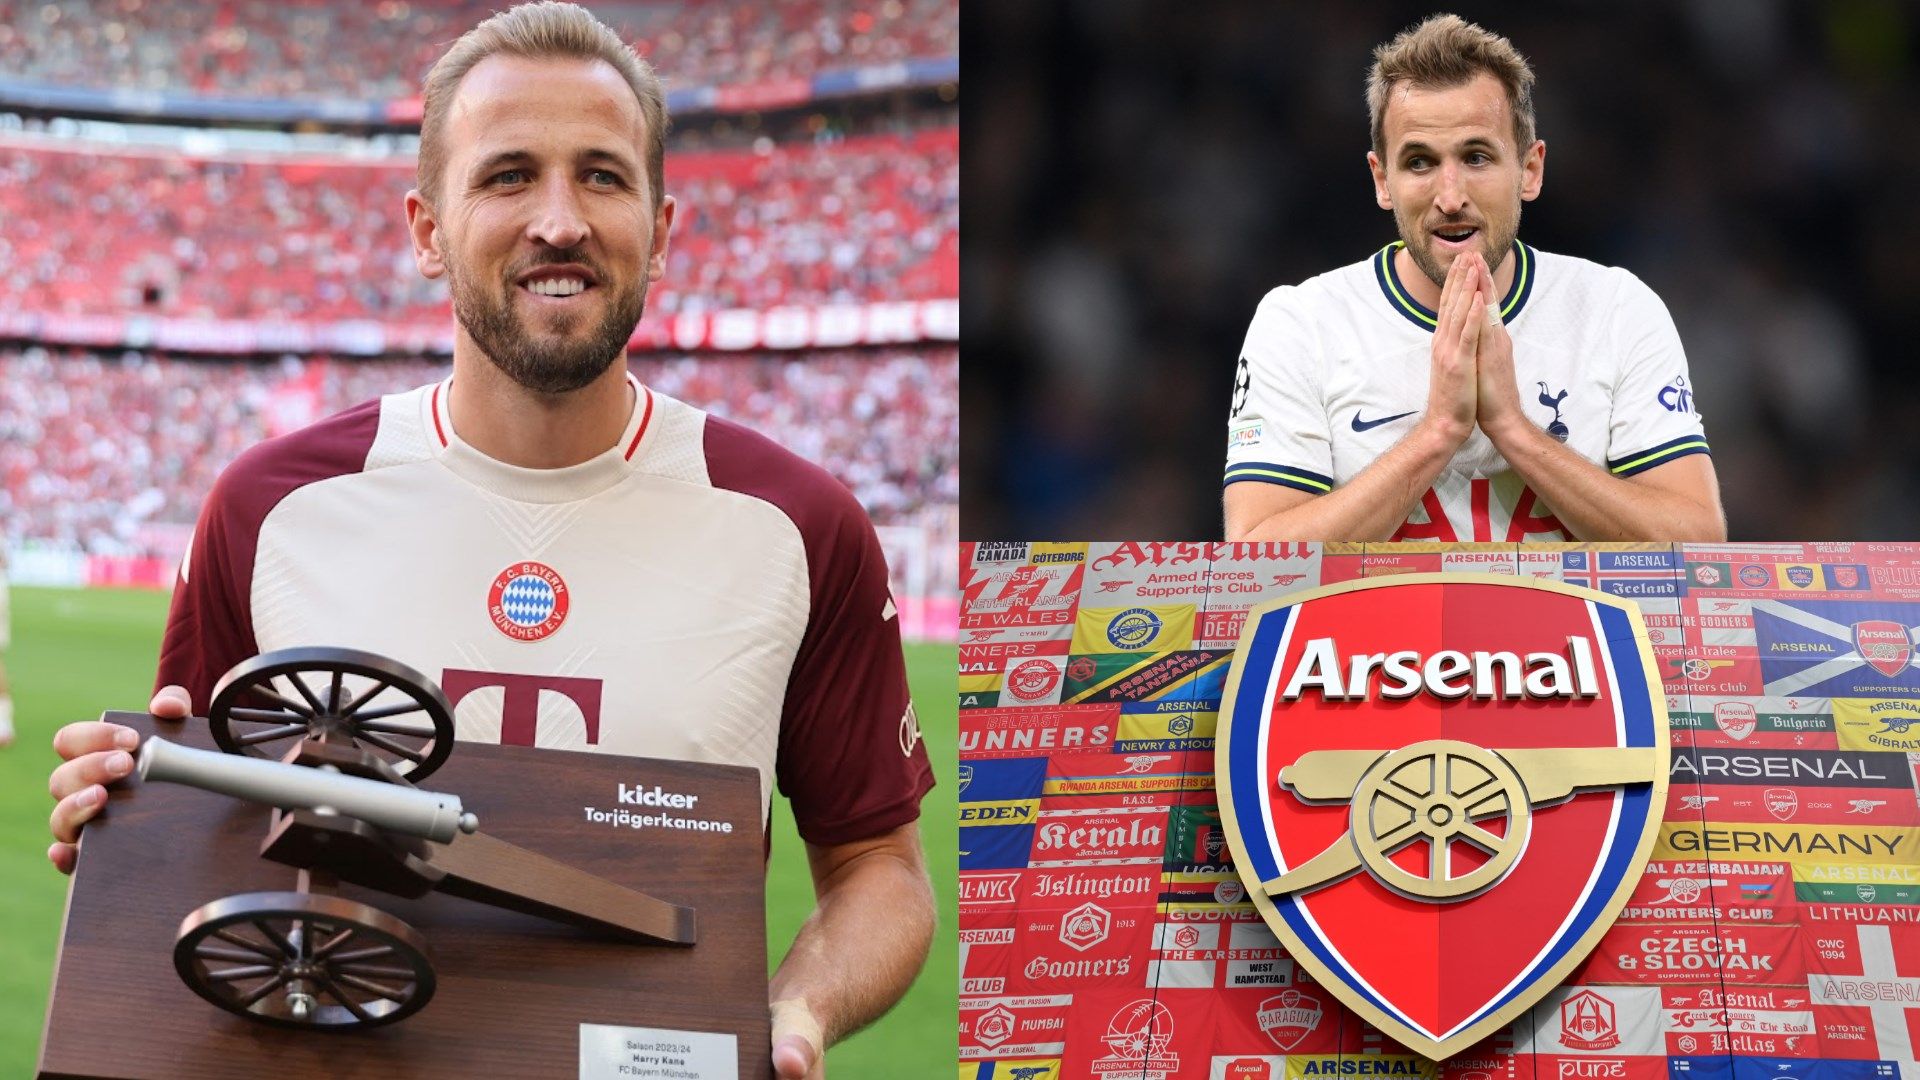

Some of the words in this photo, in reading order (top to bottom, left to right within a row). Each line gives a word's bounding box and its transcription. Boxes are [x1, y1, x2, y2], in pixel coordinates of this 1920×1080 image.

[979, 542, 1028, 550] ARSENAL
[976, 548, 1026, 562] CANADA
[1032, 552, 1084, 563] GÖTEBORG
[1091, 542, 1315, 572] Arsenal
[1361, 557, 1401, 565] KUWAIT
[1444, 553, 1513, 563] ARSENAL
[1519, 553, 1560, 563] DELHI
[1613, 555, 1670, 567] ARSENAL
[522, 564, 565, 594] BAYERN
[990, 569, 1060, 583] ARSENAL
[1146, 570, 1198, 584] Armed
[1201, 570, 1255, 582] Forces
[1136, 583, 1223, 599] Supporters
[1227, 582, 1263, 594] Club
[1612, 583, 1675, 595] Iceland
[964, 594, 1077, 610] NETHERLANDS
[491, 606, 543, 638] MÜNCHEN
[993, 611, 1070, 625] WALES
[1701, 616, 1748, 627] GOONERS
[1859, 629, 1906, 639] Arsenal
[1654, 646, 1698, 656] Arsenal
[1701, 647, 1737, 656] Tralee
[1770, 642, 1836, 652] ARSENAL
[1124, 652, 1213, 699] TANZANIA
[1281, 635, 1601, 702] Arsenal
[1109, 654, 1188, 699] ARSENAL
[1720, 682, 1747, 692] Club
[1853, 685, 1909, 693] SUPPORTERS
[442, 668, 603, 748] T
[1156, 701, 1211, 712] ARSENAL
[1720, 708, 1752, 716] Arsenal
[986, 714, 1064, 730] BELFAST
[1769, 716, 1827, 730] Bulgaria
[958, 725, 1110, 752] UNNERS
[1121, 740, 1165, 752] NEWRY
[1168, 740, 1177, 750] &
[1669, 755, 1887, 780] ARSENAL
[1059, 782, 1098, 792] RWANDA
[1098, 781, 1138, 791] ARSENAL
[1140, 778, 1198, 789] SUPPORTERS
[617, 783, 698, 809] kicker
[1122, 795, 1155, 805] R.A.S.C
[584, 806, 734, 834] Torjägerkanone
[959, 805, 1032, 821] EDEN
[1036, 817, 1163, 851] Kerala
[1668, 829, 1904, 857] GERMANY
[1673, 862, 1785, 876] AZERBAIJAN
[1811, 865, 1916, 881] ARSENAL
[1031, 872, 1152, 899] Islington
[1728, 907, 1774, 920] CLUB
[1028, 922, 1055, 932] Since
[1115, 919, 1136, 928] 1913
[1640, 937, 1747, 954] CZECH
[1816, 939, 1845, 949] CWC
[1163, 950, 1196, 960] THE
[1203, 949, 1284, 960] ARSENAL
[1819, 951, 1846, 960] 1994
[1023, 954, 1132, 981] Gooners
[1249, 963, 1274, 973] WEST
[1618, 954, 1638, 970] &
[1643, 954, 1774, 971] SLOVAK
[963, 979, 1003, 993] CLUB
[1234, 974, 1286, 984] HAMPSTEAD
[1698, 989, 1777, 1009] Arsenal
[1020, 1017, 1065, 1031] MUMBAI
[1259, 1009, 1321, 1028] PARAGUAY
[1740, 1021, 1756, 1031] On
[1760, 1022, 1779, 1032] The
[1782, 1023, 1809, 1033] Road
[1823, 1024, 1836, 1032] 1-0
[1850, 1025, 1867, 1033] THE
[1710, 1033, 1776, 1054] Hellas
[1827, 1032, 1866, 1041] ARSENAL
[626, 1040, 654, 1052] Saison
[655, 1043, 692, 1055] 2023/24
[965, 1048, 980, 1056] LOVE
[1011, 1046, 1037, 1054] ARSENAL
[633, 1054, 660, 1065] Harry
[662, 1056, 686, 1066] Kane
[1094, 1061, 1132, 1071] ARSENAL
[1133, 1060, 1177, 1070] FOOTBALL
[1450, 1060, 1504, 1069] ARSENAL
[619, 1065, 631, 1074] FC
[631, 1066, 660, 1077] Bayern
[660, 1068, 700, 1079] München
[1234, 1064, 1263, 1073] Arsenal
[1303, 1060, 1422, 1075] ARSENAL
[1106, 1071, 1162, 1079] SUPPORTERS
